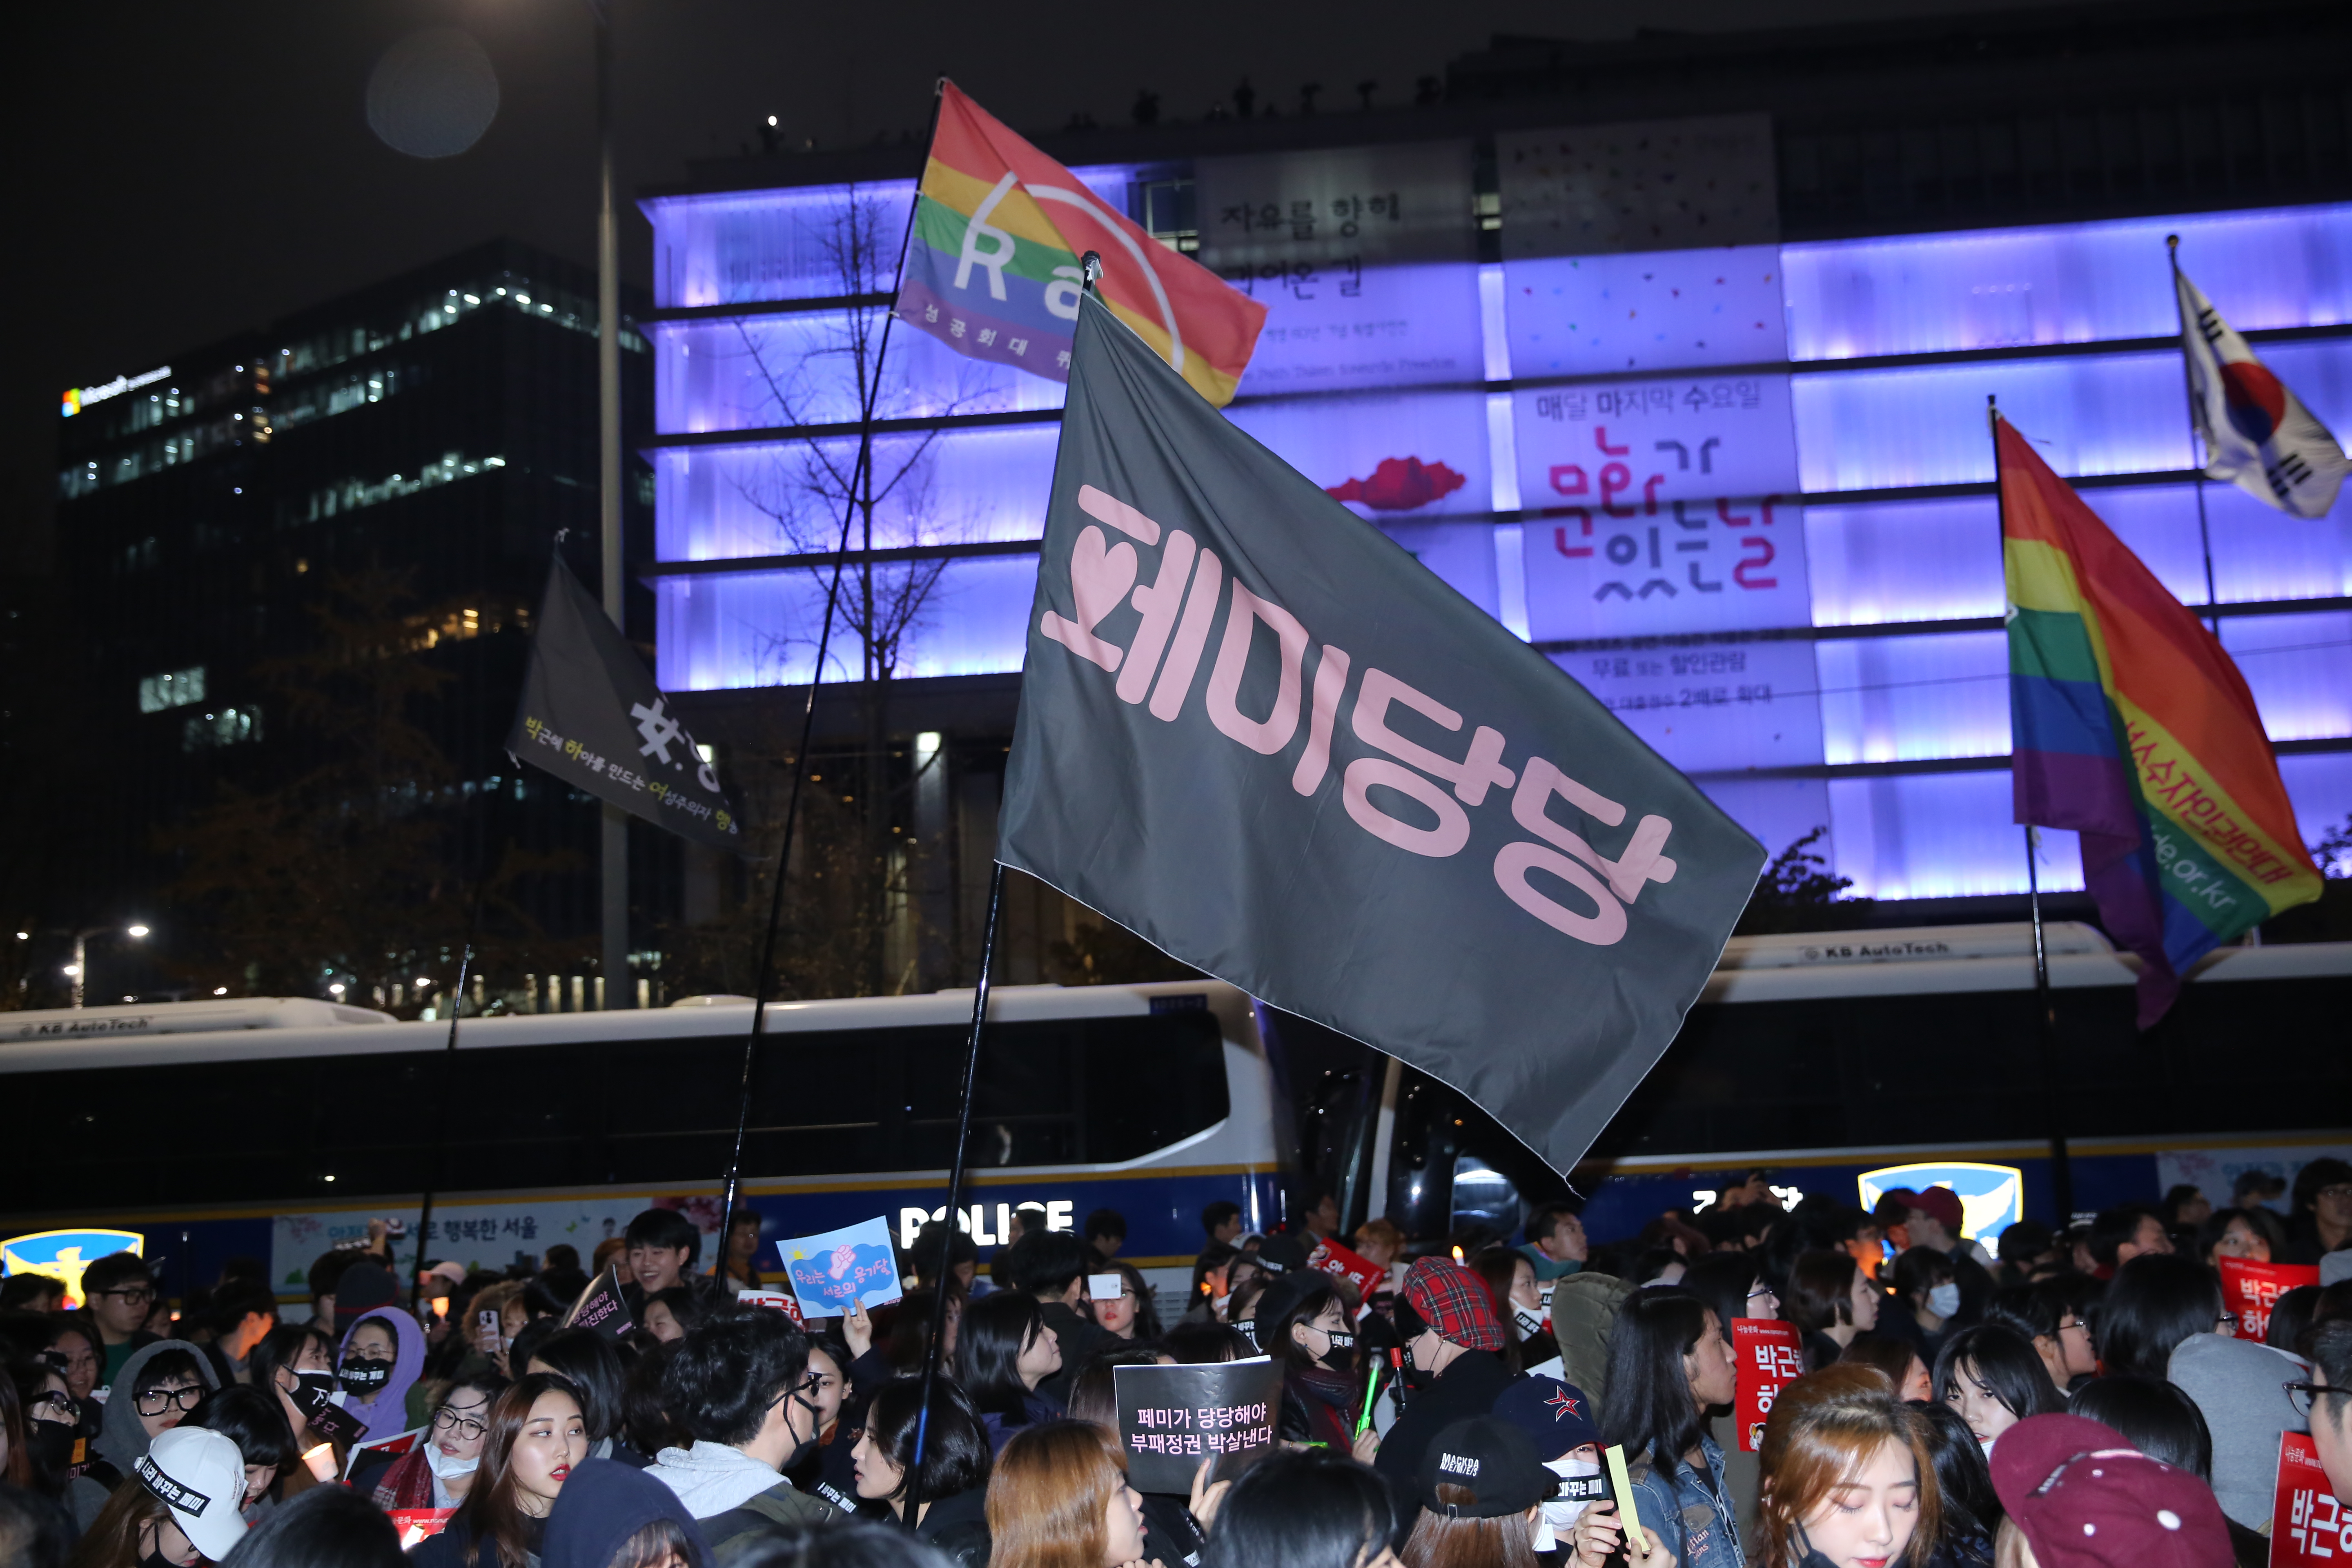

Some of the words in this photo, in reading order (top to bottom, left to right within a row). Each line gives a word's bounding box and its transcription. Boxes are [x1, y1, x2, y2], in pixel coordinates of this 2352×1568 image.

[1221, 198, 1317, 241] 자유를
[925, 303, 1029, 357] 성공회대
[1536, 392, 1587, 422] 매달
[1596, 387, 1675, 417] 마지막
[1682, 380, 1760, 413] 수요일
[1040, 483, 1678, 947] 페미당당
[608, 763, 646, 792] 만드는
[2152, 829, 2237, 909] de.or.kr
[1824, 945, 1853, 959] KB
[1860, 942, 1949, 957] AutoTech
[38, 1022, 63, 1035] KB
[69, 1018, 149, 1034] AutoTech
[444, 1219, 499, 1243] 행복한
[502, 1215, 538, 1240] 서울
[900, 1200, 1074, 1250] PLIE
[795, 1269, 825, 1285] 우리는
[854, 1258, 891, 1283] 용기당
[823, 1282, 857, 1298] 서로의
[1756, 1383, 1779, 1414] 하
[1137, 1408, 1192, 1429] 페미가
[1198, 1402, 1267, 1430] 당당해야
[1131, 1433, 1202, 1455] 부패정권
[1208, 1424, 1273, 1454] 박살낸다
[1441, 1452, 1479, 1469] MACKDA
[151, 1474, 181, 1501] 바꾸는
[178, 1492, 205, 1511] 페미
[1557, 1481, 1587, 1497] 바꾸는
